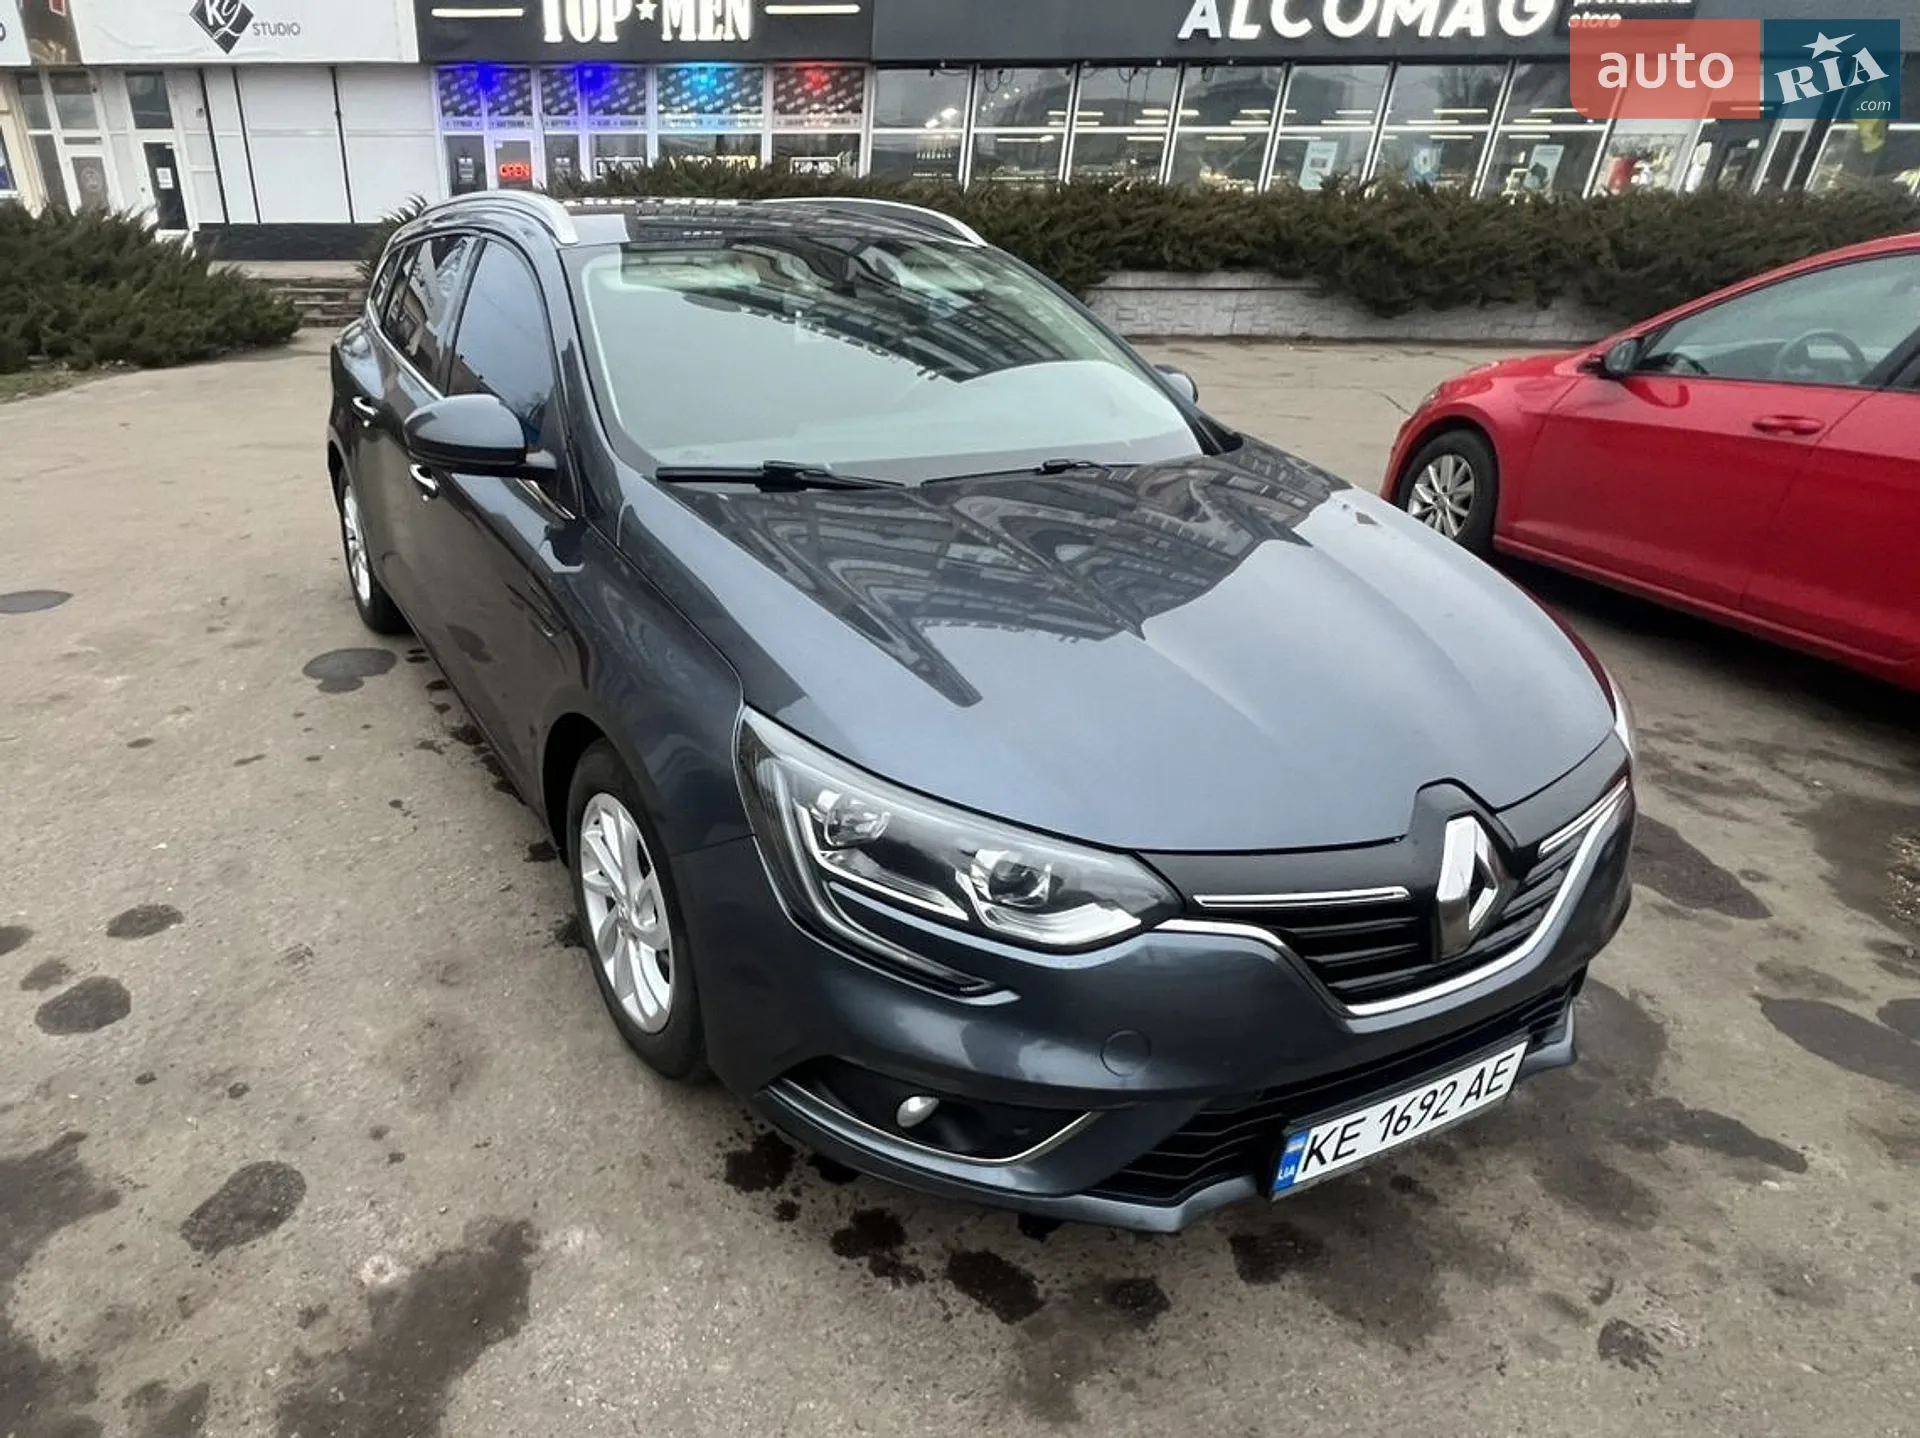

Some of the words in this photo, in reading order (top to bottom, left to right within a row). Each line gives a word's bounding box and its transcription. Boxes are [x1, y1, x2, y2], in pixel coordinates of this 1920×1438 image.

[252, 22, 301, 37] STUDIO
[542, 0, 633, 43] TOP
[661, 0, 753, 42] MEN
[1178, 0, 1556, 39] ALCOMAG
[1568, 11, 1622, 28] store
[499, 162, 530, 177] OPEN
[1302, 1116, 1366, 1172] KE
[1379, 1080, 1457, 1143] 1692
[1461, 1053, 1516, 1108] AE
